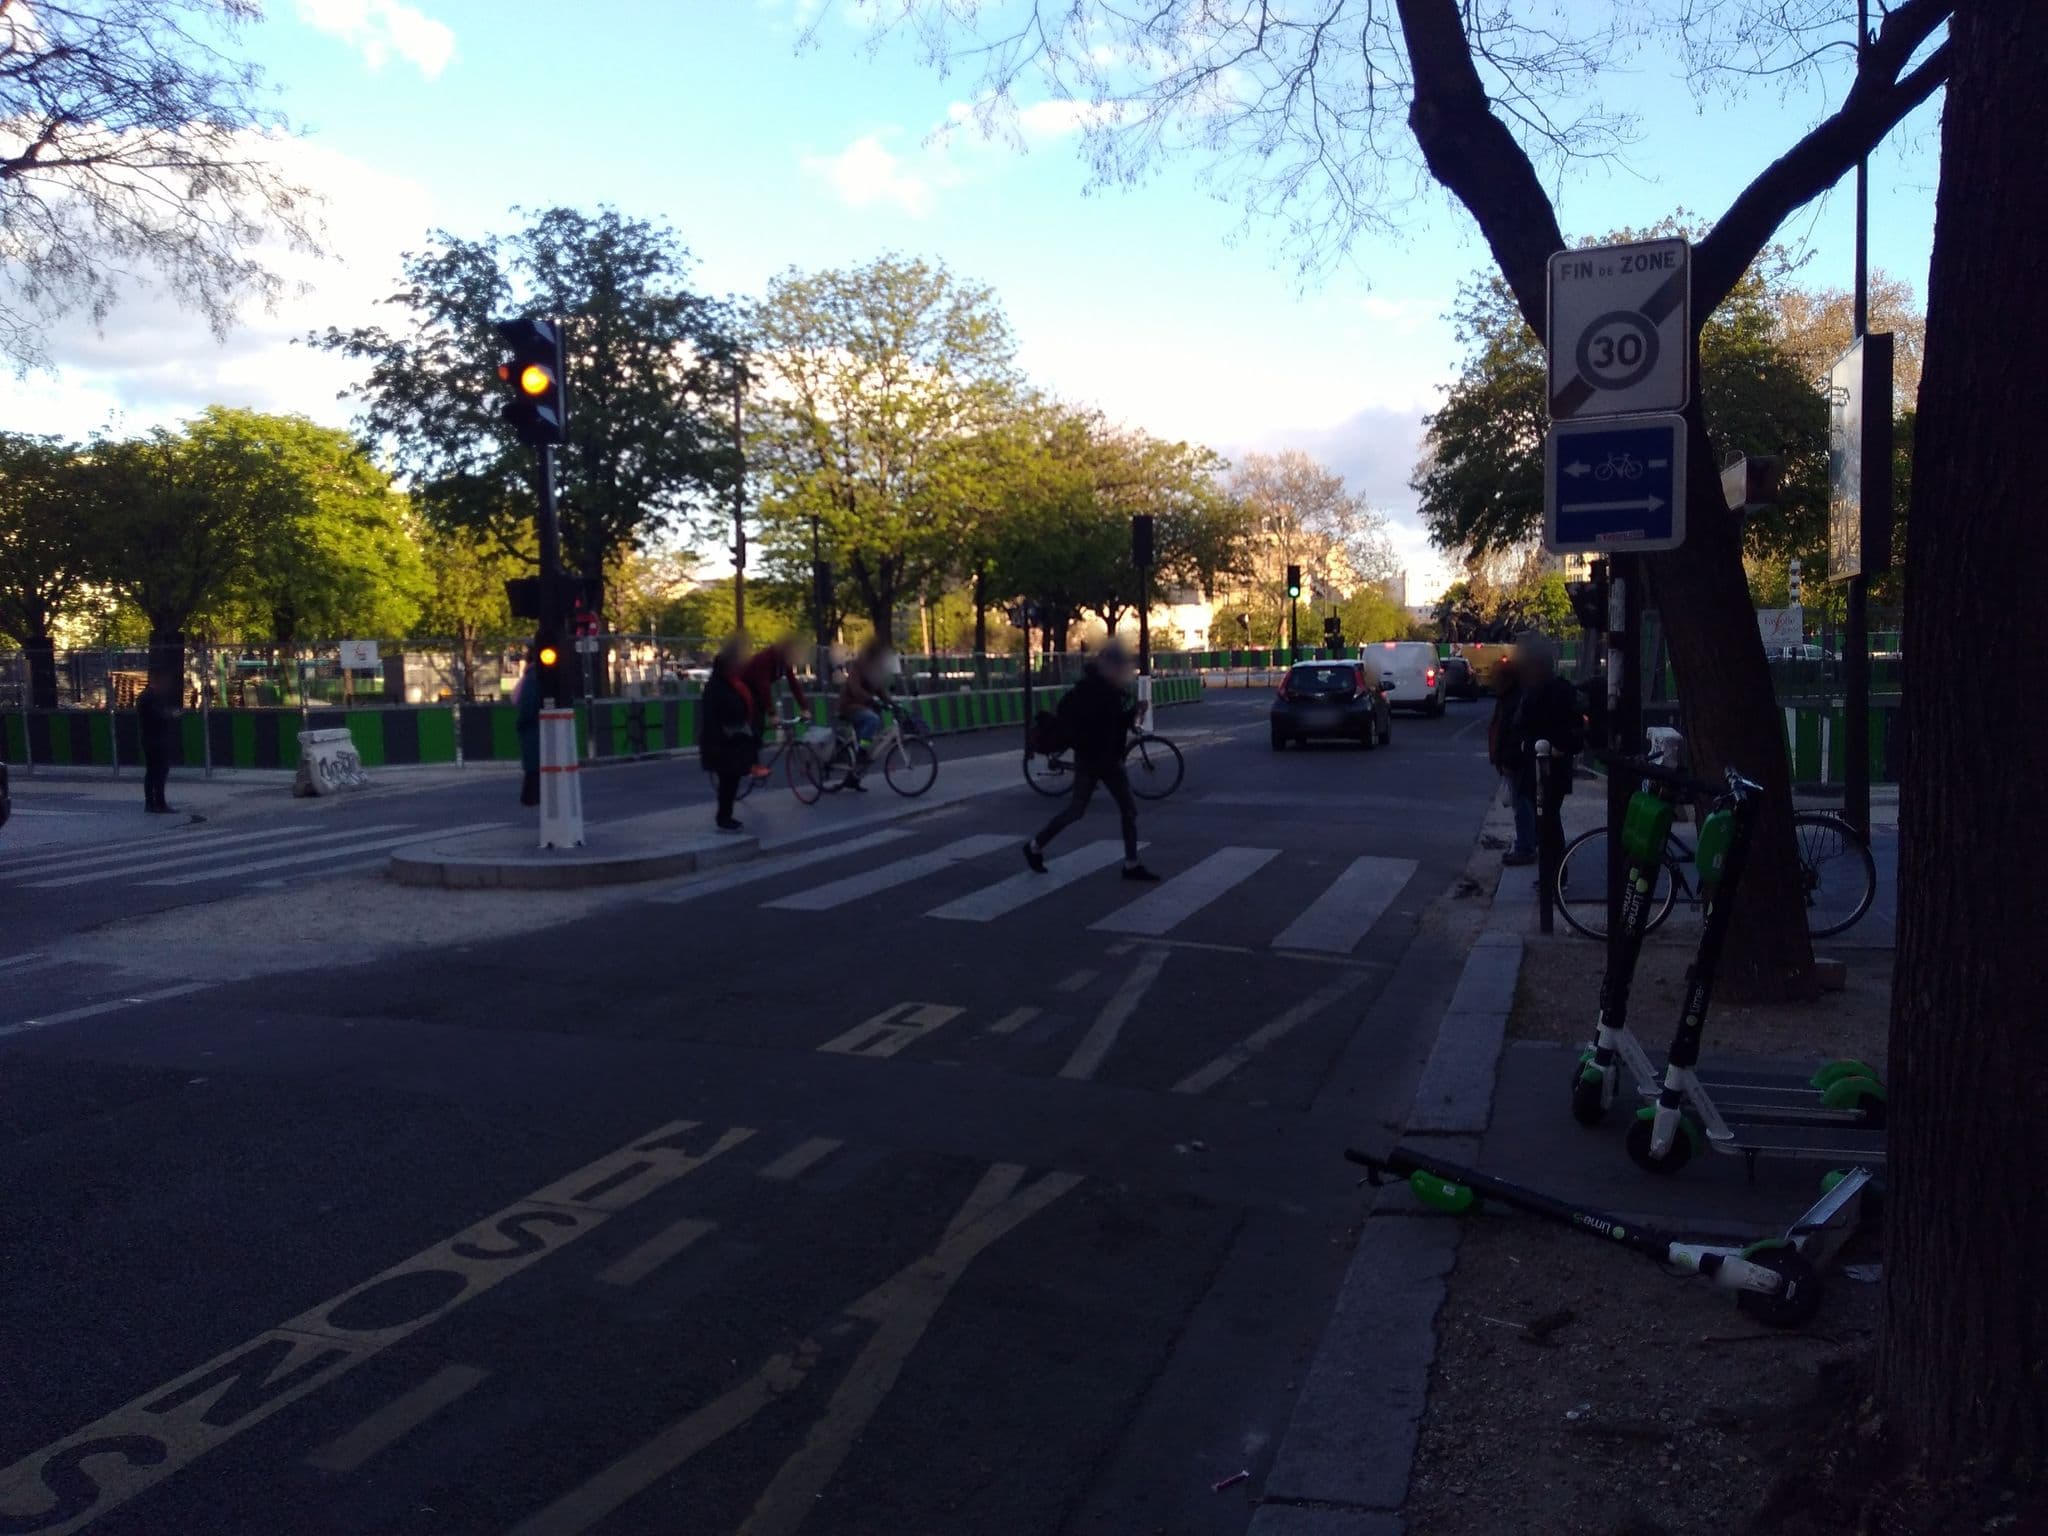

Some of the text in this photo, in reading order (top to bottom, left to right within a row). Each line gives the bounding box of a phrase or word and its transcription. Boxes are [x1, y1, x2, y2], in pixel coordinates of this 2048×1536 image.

[1561, 261, 1593, 280] FIN
[1621, 251, 1676, 274] ZONE
[1593, 333, 1643, 369] 30
